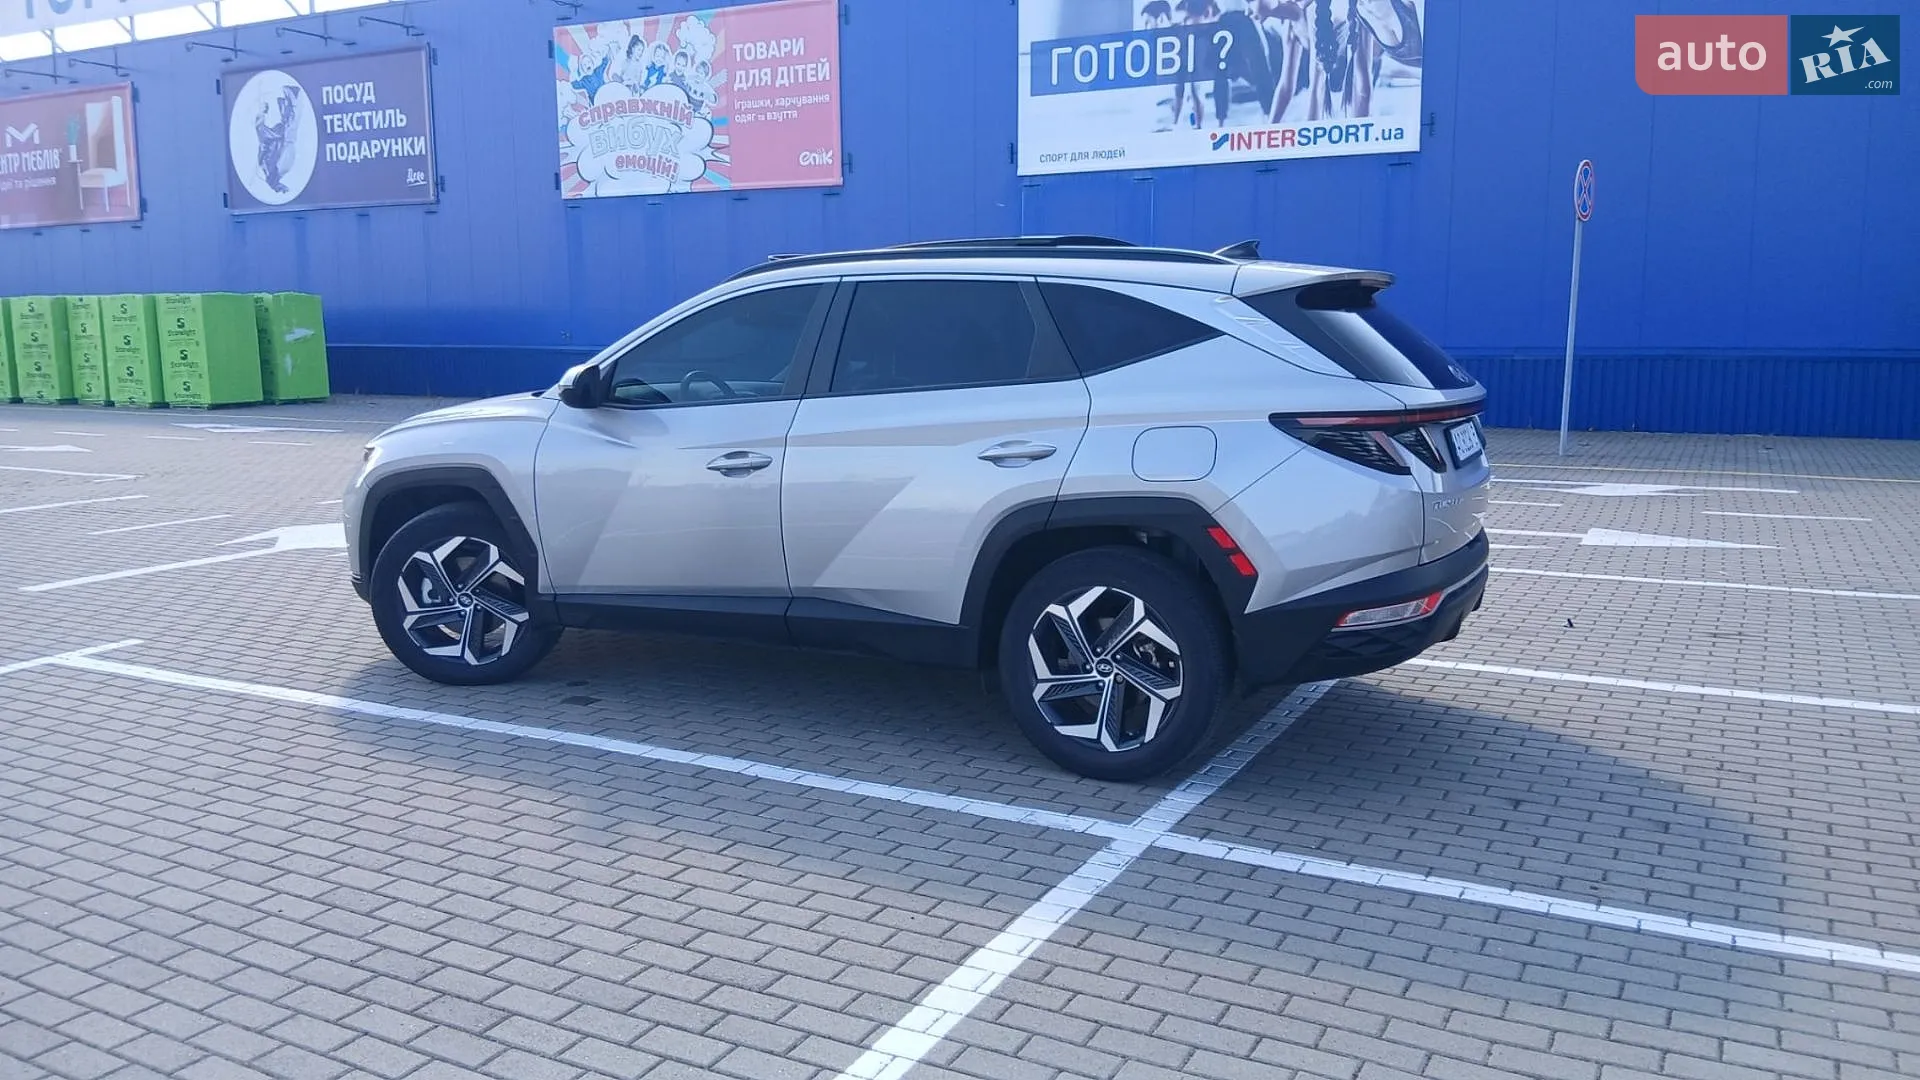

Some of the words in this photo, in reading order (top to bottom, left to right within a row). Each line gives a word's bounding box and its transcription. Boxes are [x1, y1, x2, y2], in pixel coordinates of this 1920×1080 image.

[733, 37, 804, 62] ТОВАРИ
[1051, 33, 1195, 86] ГОТОВІ
[1212, 30, 1234, 70] ?
[733, 67, 772, 91] ДЛЯ
[775, 57, 831, 88] ДІТЕЙ
[321, 81, 376, 105] ПОСУД
[323, 108, 407, 134] ТЕКСТИЛЬ
[325, 136, 426, 164] ПОДАРУНКИ
[1039, 152, 1068, 163] СПОРТ
[1069, 151, 1090, 163] ДЛЯ
[1091, 147, 1126, 161] ЛЮДЕЙ
